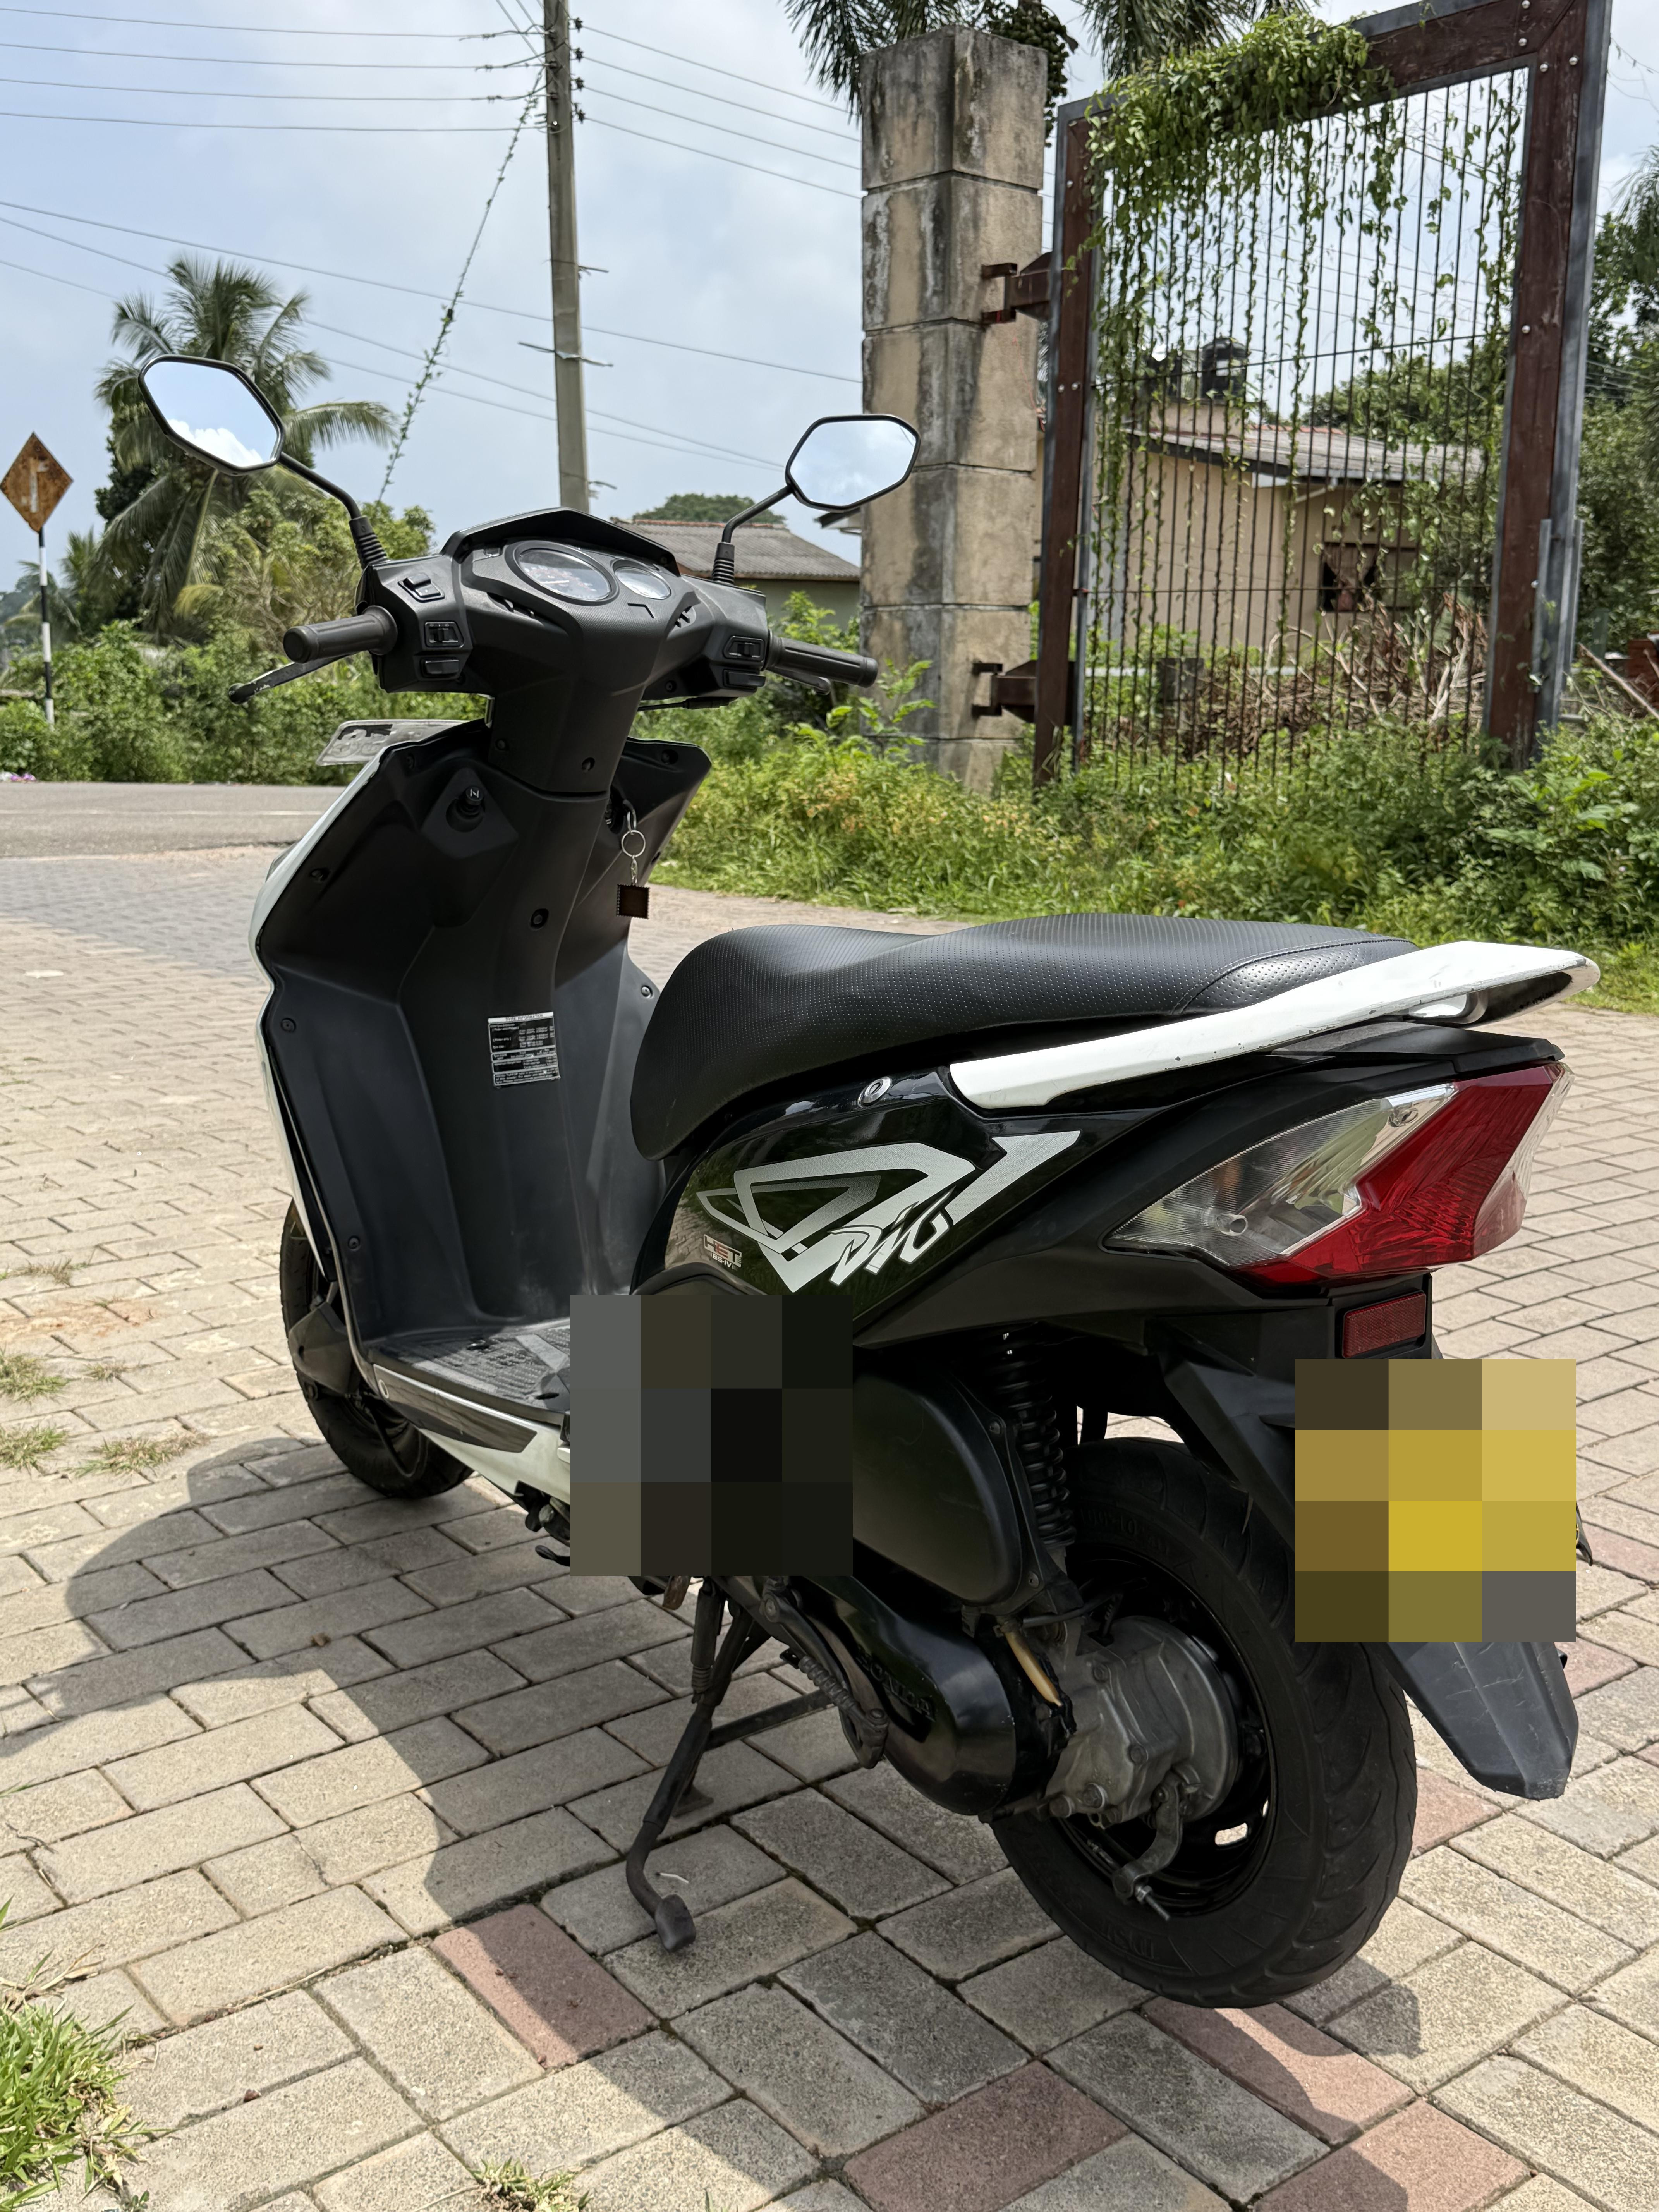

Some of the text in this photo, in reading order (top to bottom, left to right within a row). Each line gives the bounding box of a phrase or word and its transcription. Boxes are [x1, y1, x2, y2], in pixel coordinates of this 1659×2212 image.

[704, 1235, 741, 1264] HET
[712, 1253, 732, 1268] BS-IV
[856, 1645, 936, 1722] HONDA
